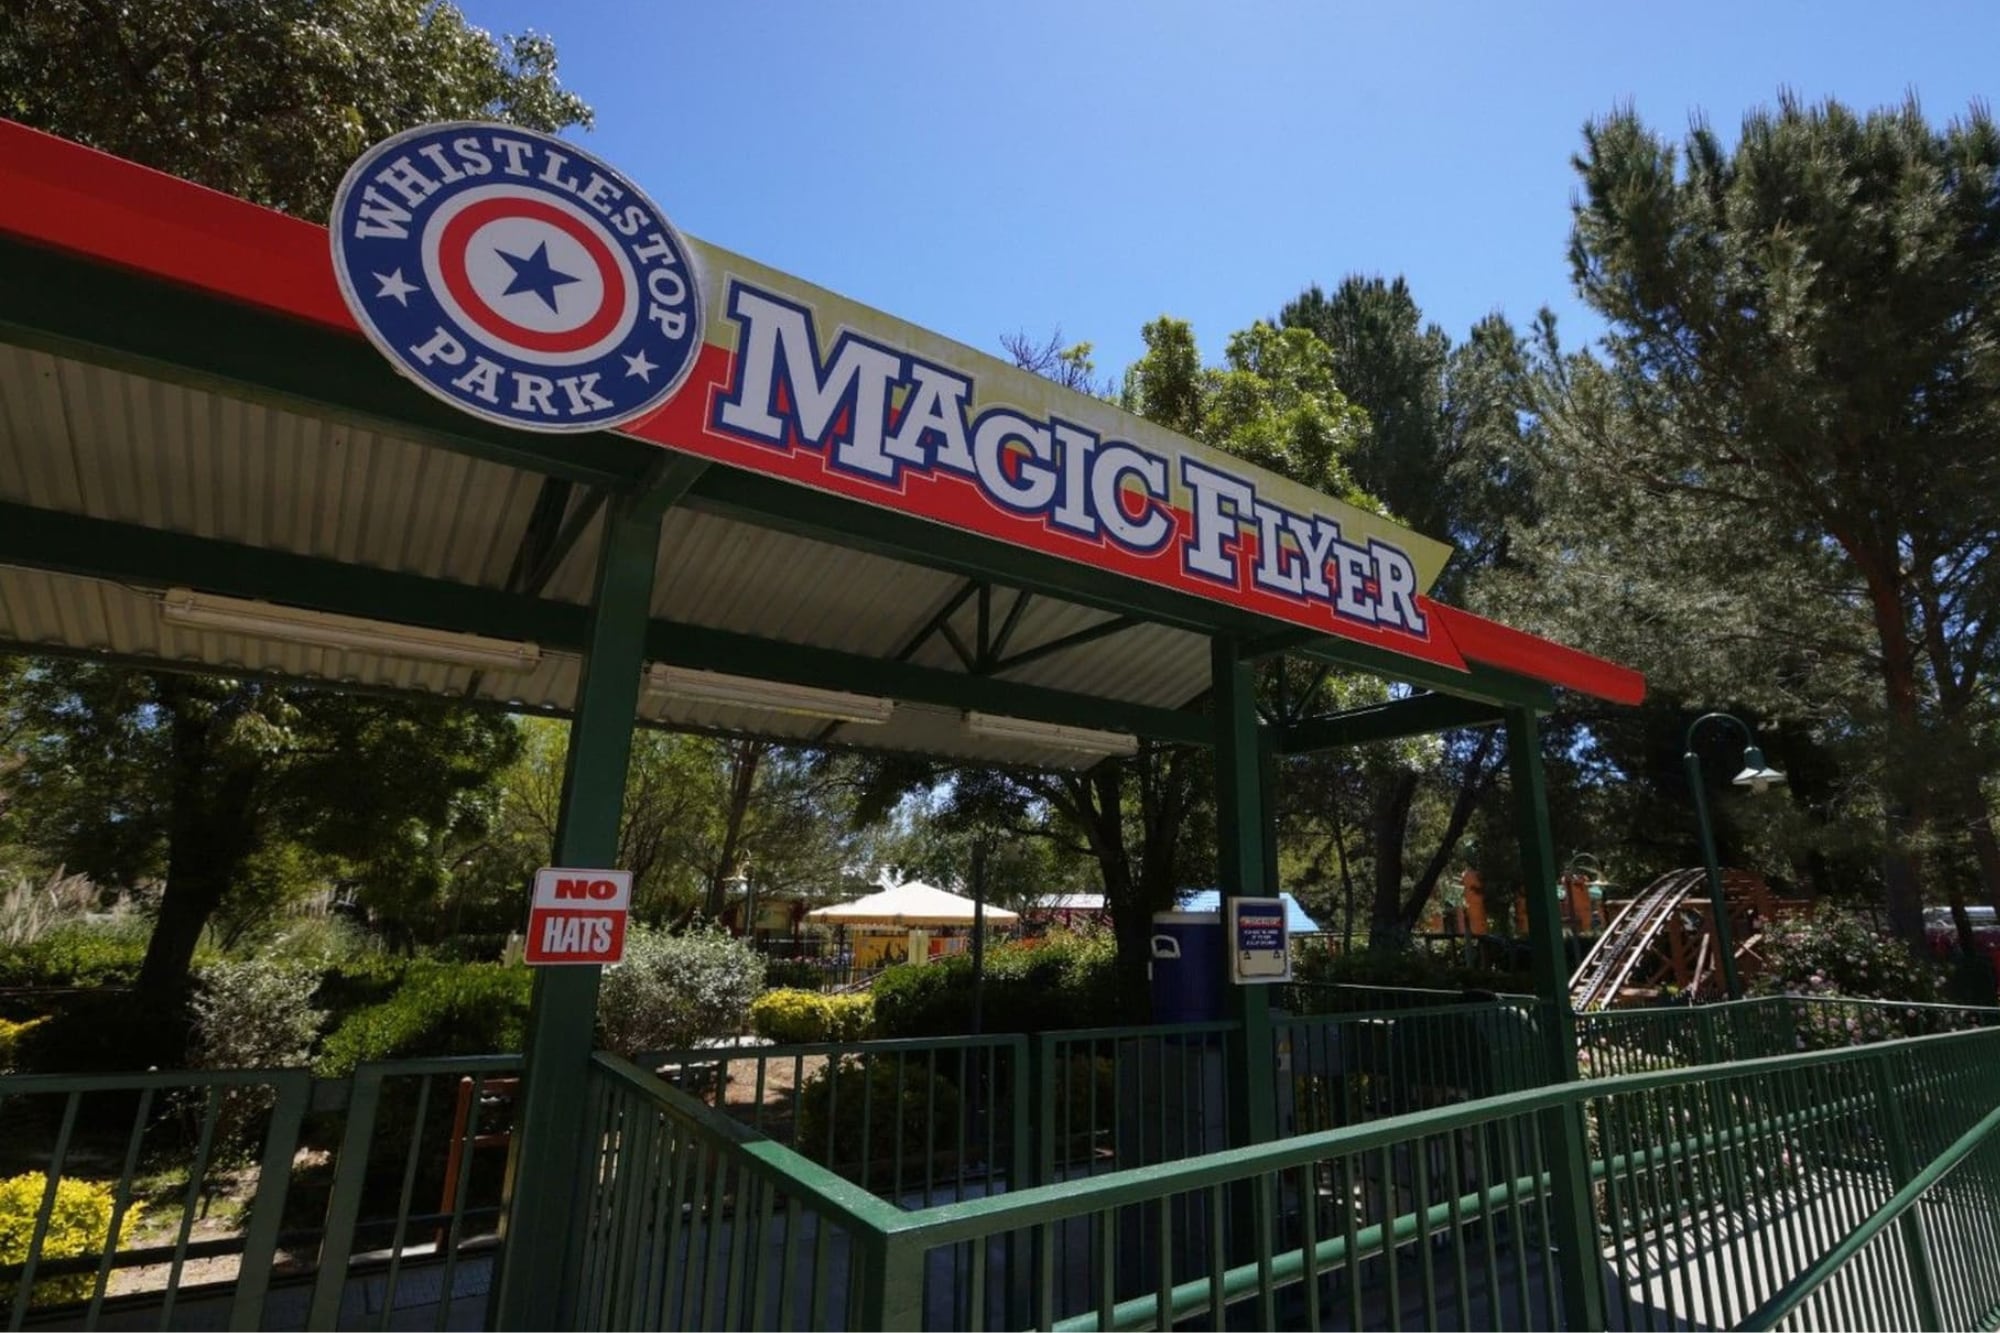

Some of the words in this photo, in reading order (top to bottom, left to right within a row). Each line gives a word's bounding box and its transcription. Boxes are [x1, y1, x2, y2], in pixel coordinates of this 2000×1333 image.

[354, 136, 687, 341] WHISTLESTOP
[409, 326, 614, 416] PARK
[714, 282, 1174, 553] MAGIC
[1183, 457, 1427, 636] FLYER
[554, 878, 618, 900] NO
[541, 916, 613, 953] HATS
